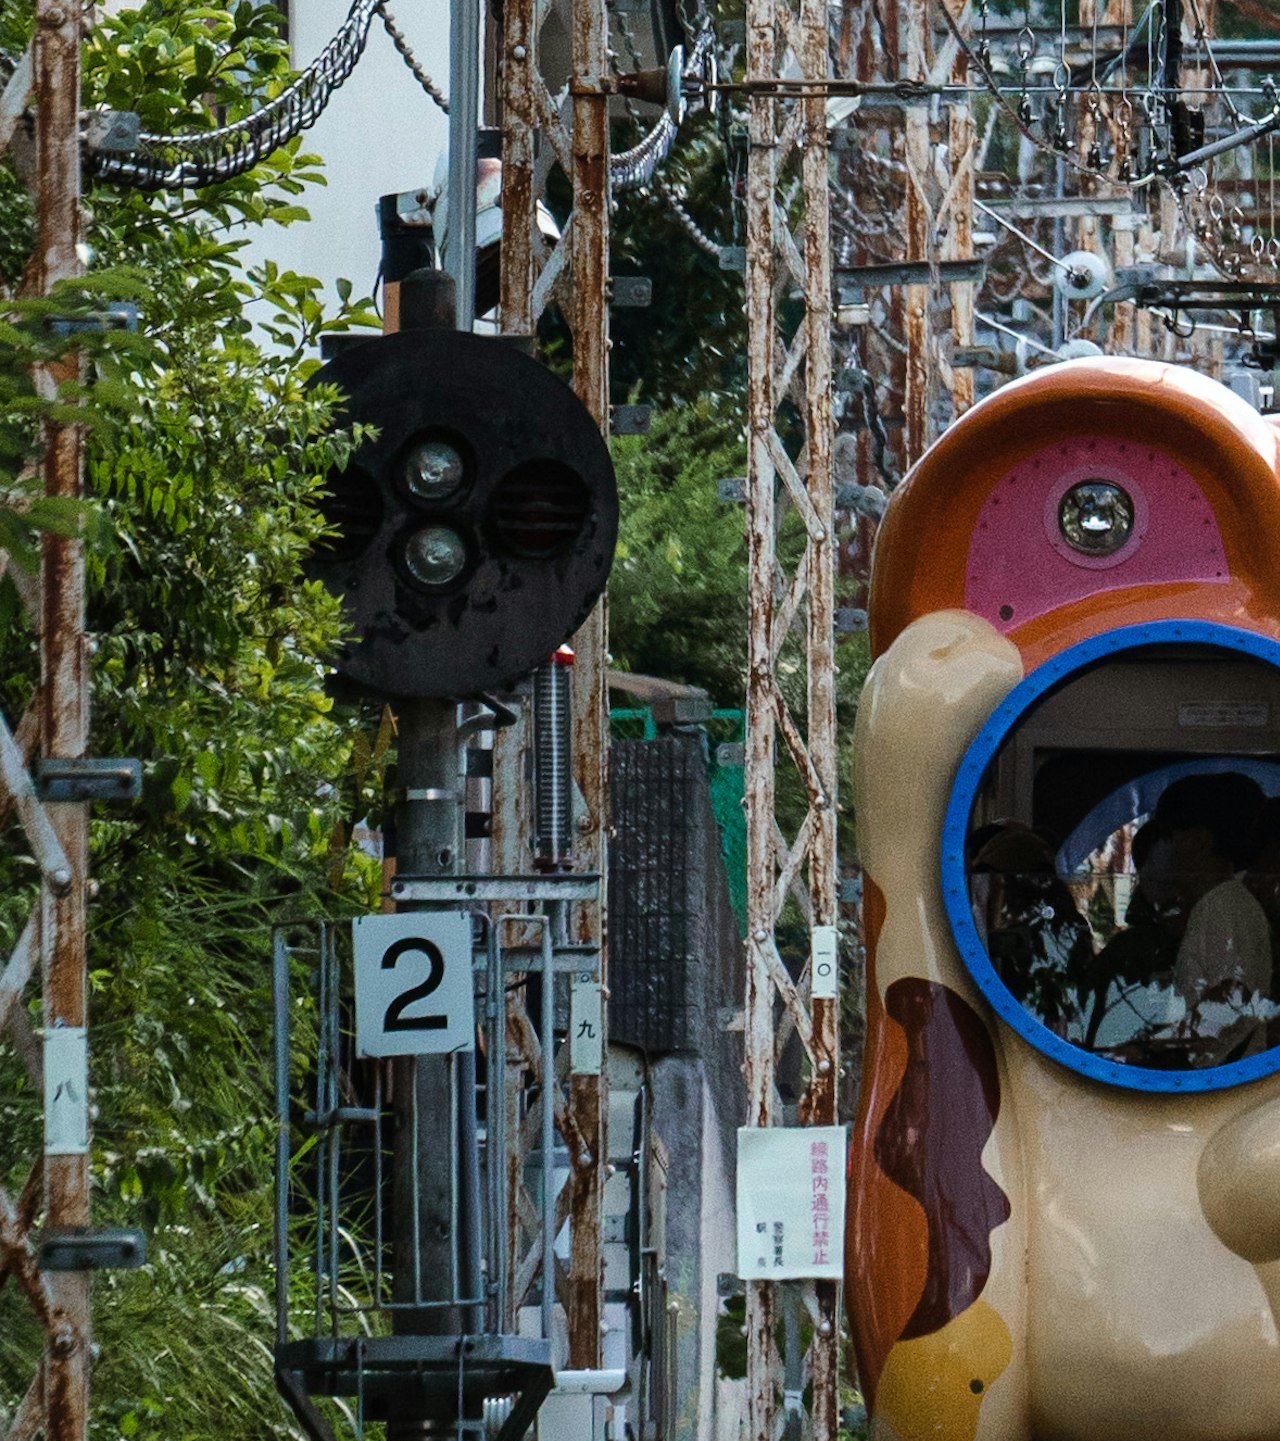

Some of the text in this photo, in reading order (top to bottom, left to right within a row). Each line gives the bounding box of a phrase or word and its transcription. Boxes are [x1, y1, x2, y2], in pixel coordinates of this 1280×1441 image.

[381, 936, 449, 1033] 2
[577, 1019, 597, 1039] 九
[811, 1141, 829, 1265] 線路内通行禁止
